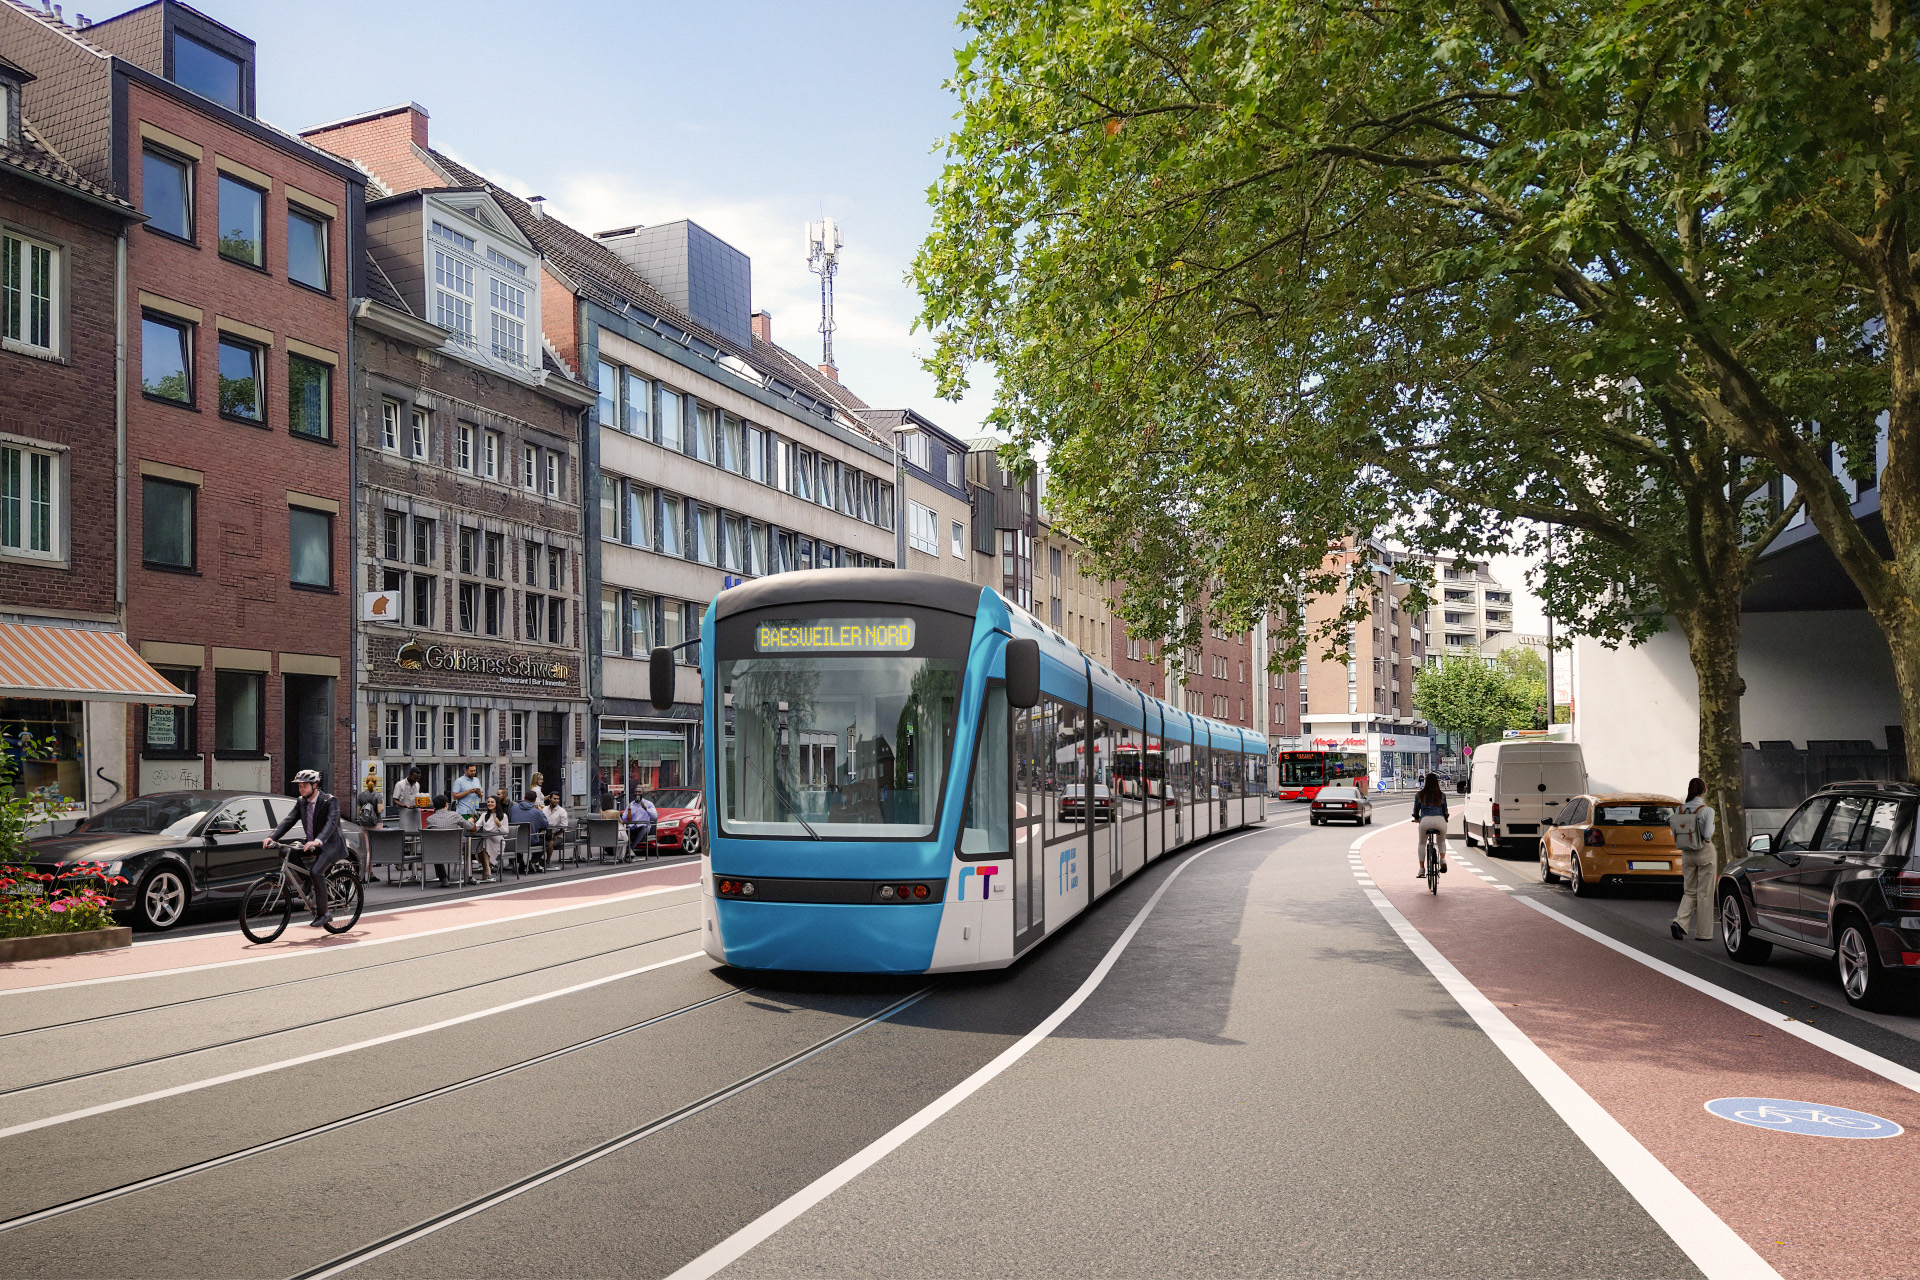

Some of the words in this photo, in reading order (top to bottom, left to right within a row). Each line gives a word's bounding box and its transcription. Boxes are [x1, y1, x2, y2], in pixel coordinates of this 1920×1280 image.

[761, 626, 861, 646] BAESWEILER
[865, 625, 910, 646] NORD
[425, 645, 505, 675] Goldenes
[507, 654, 569, 680] Schwein
[499, 676, 529, 685] Restaurant
[532, 678, 542, 686] Bar
